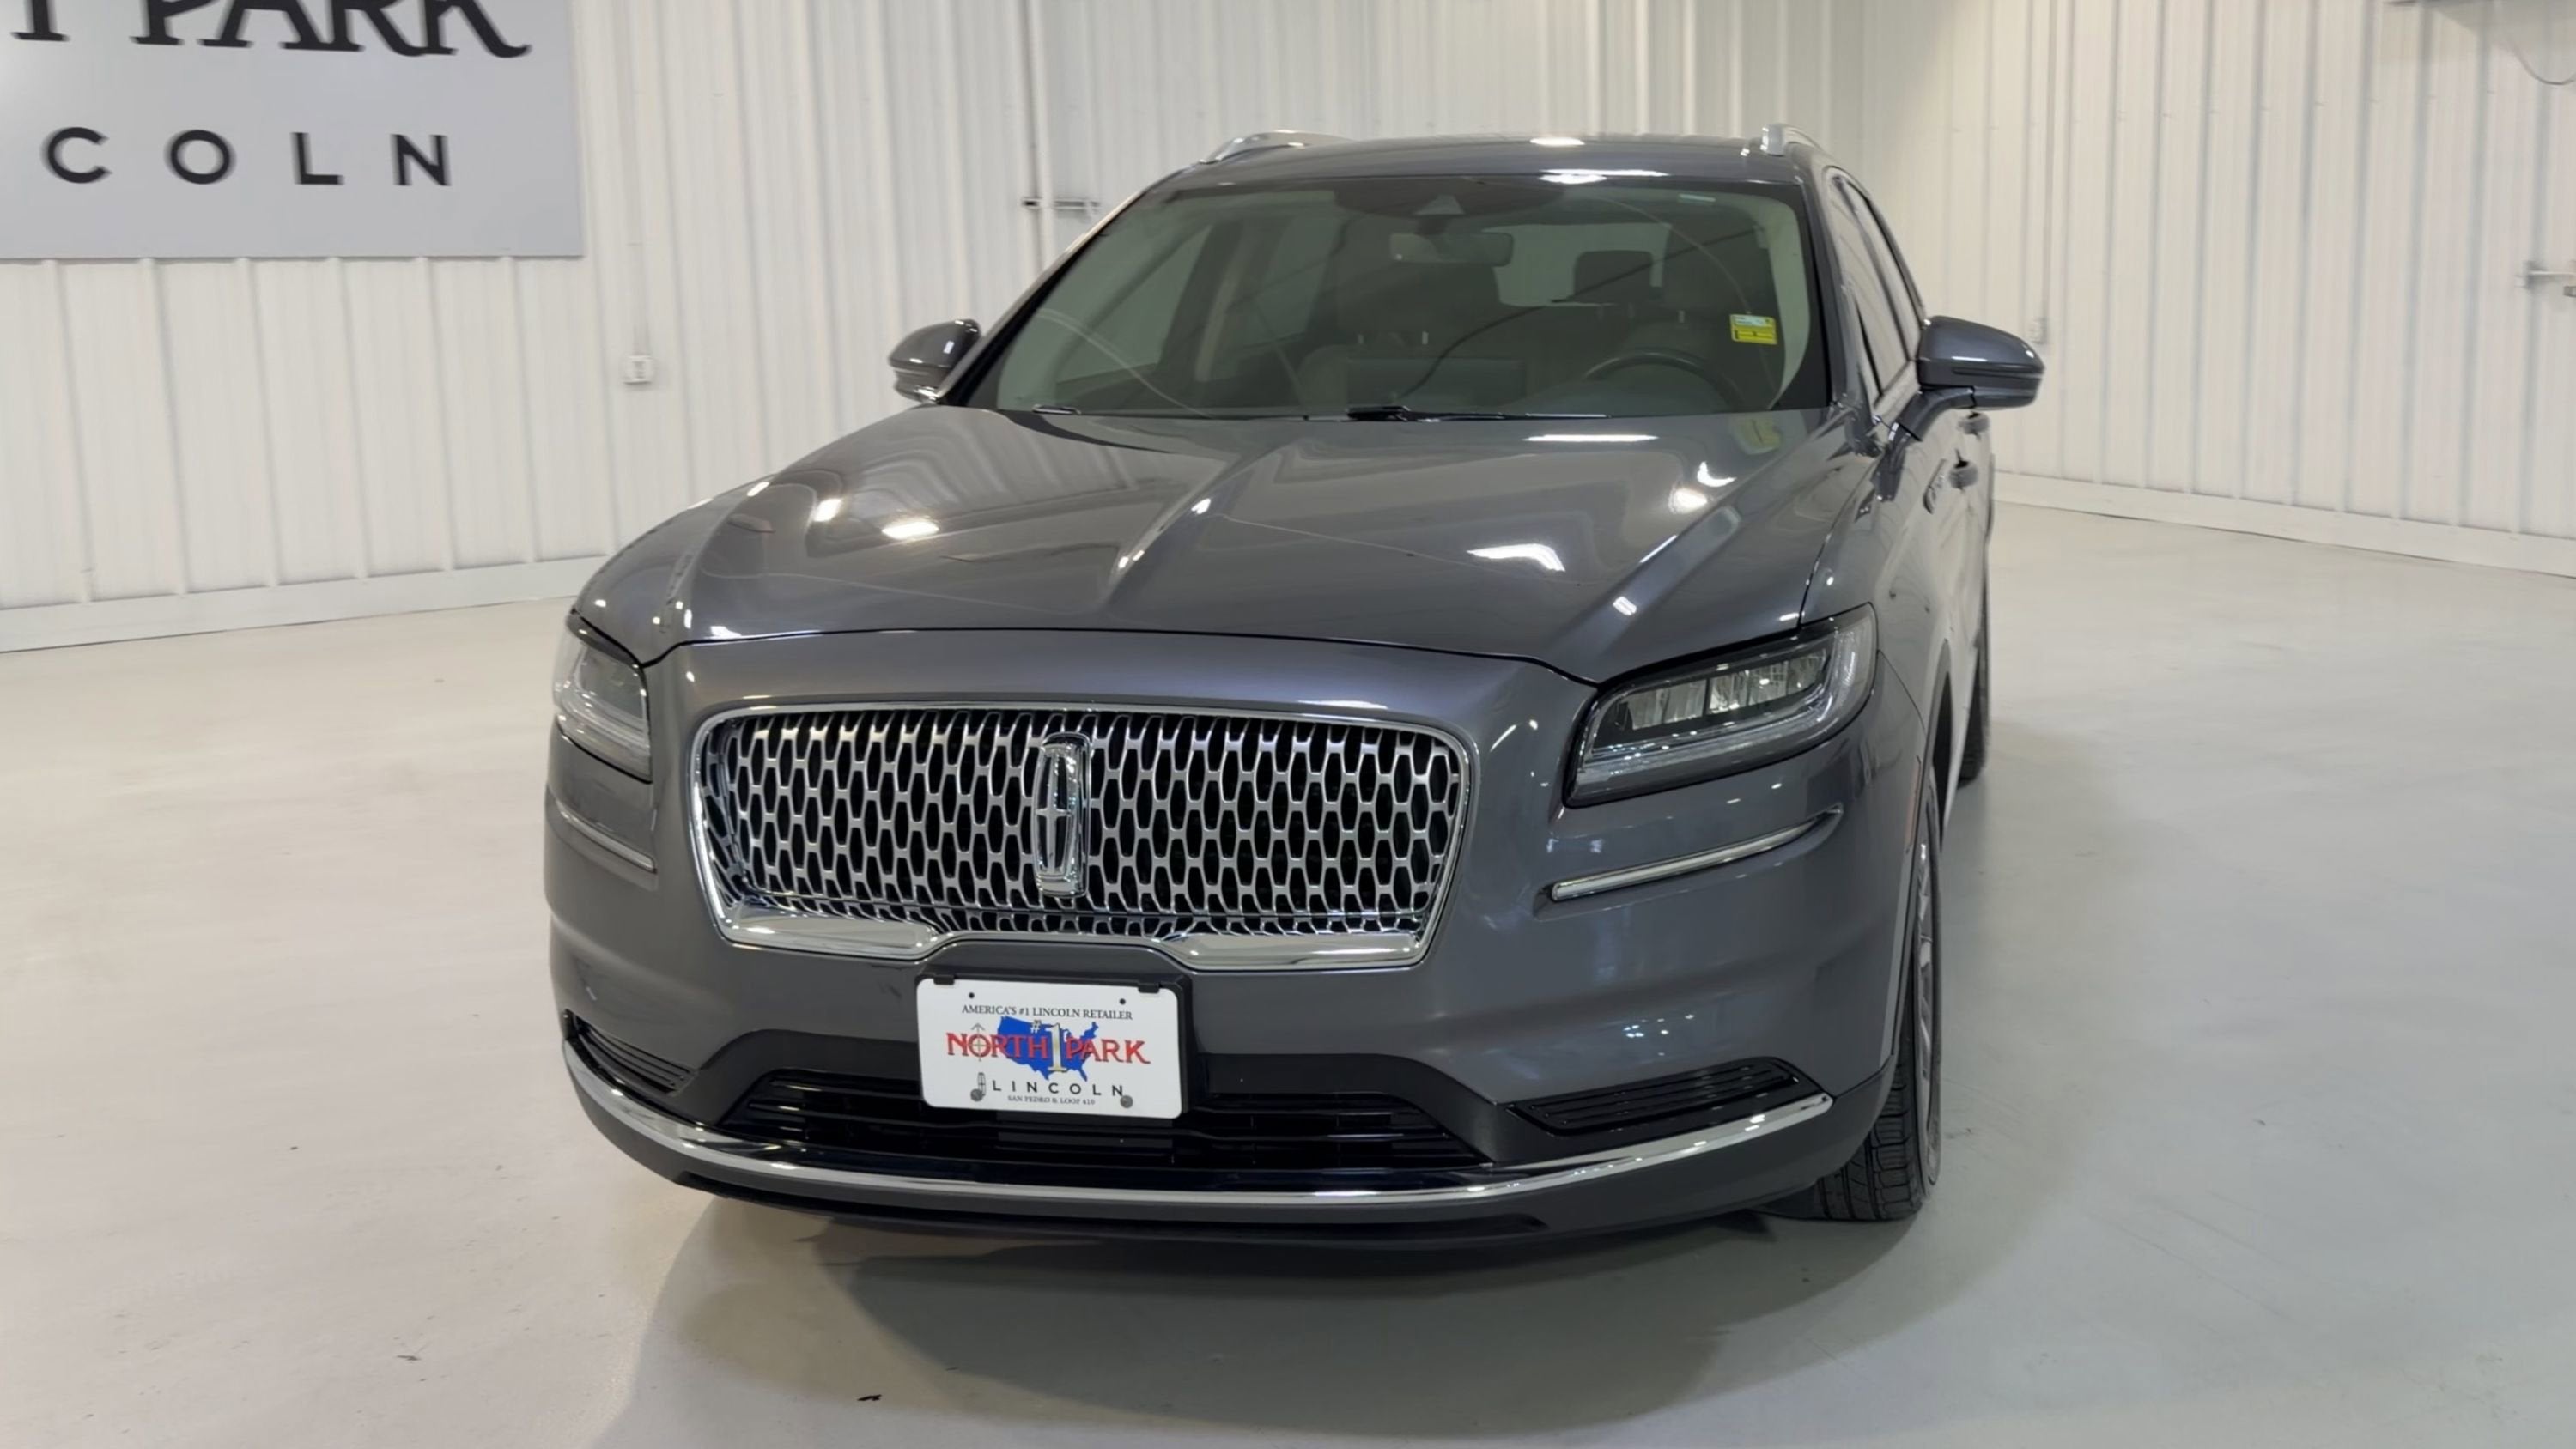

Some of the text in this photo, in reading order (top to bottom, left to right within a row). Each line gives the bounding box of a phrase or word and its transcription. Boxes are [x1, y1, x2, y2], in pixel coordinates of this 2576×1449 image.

[962, 1004, 1133, 1020] AMERICA'S #1 LINCOLN RETAILER
[946, 1033, 1151, 1064] NORTH PARK
[992, 1080, 1123, 1096] LINCOLN
[1007, 1094, 1023, 1103] SAN
